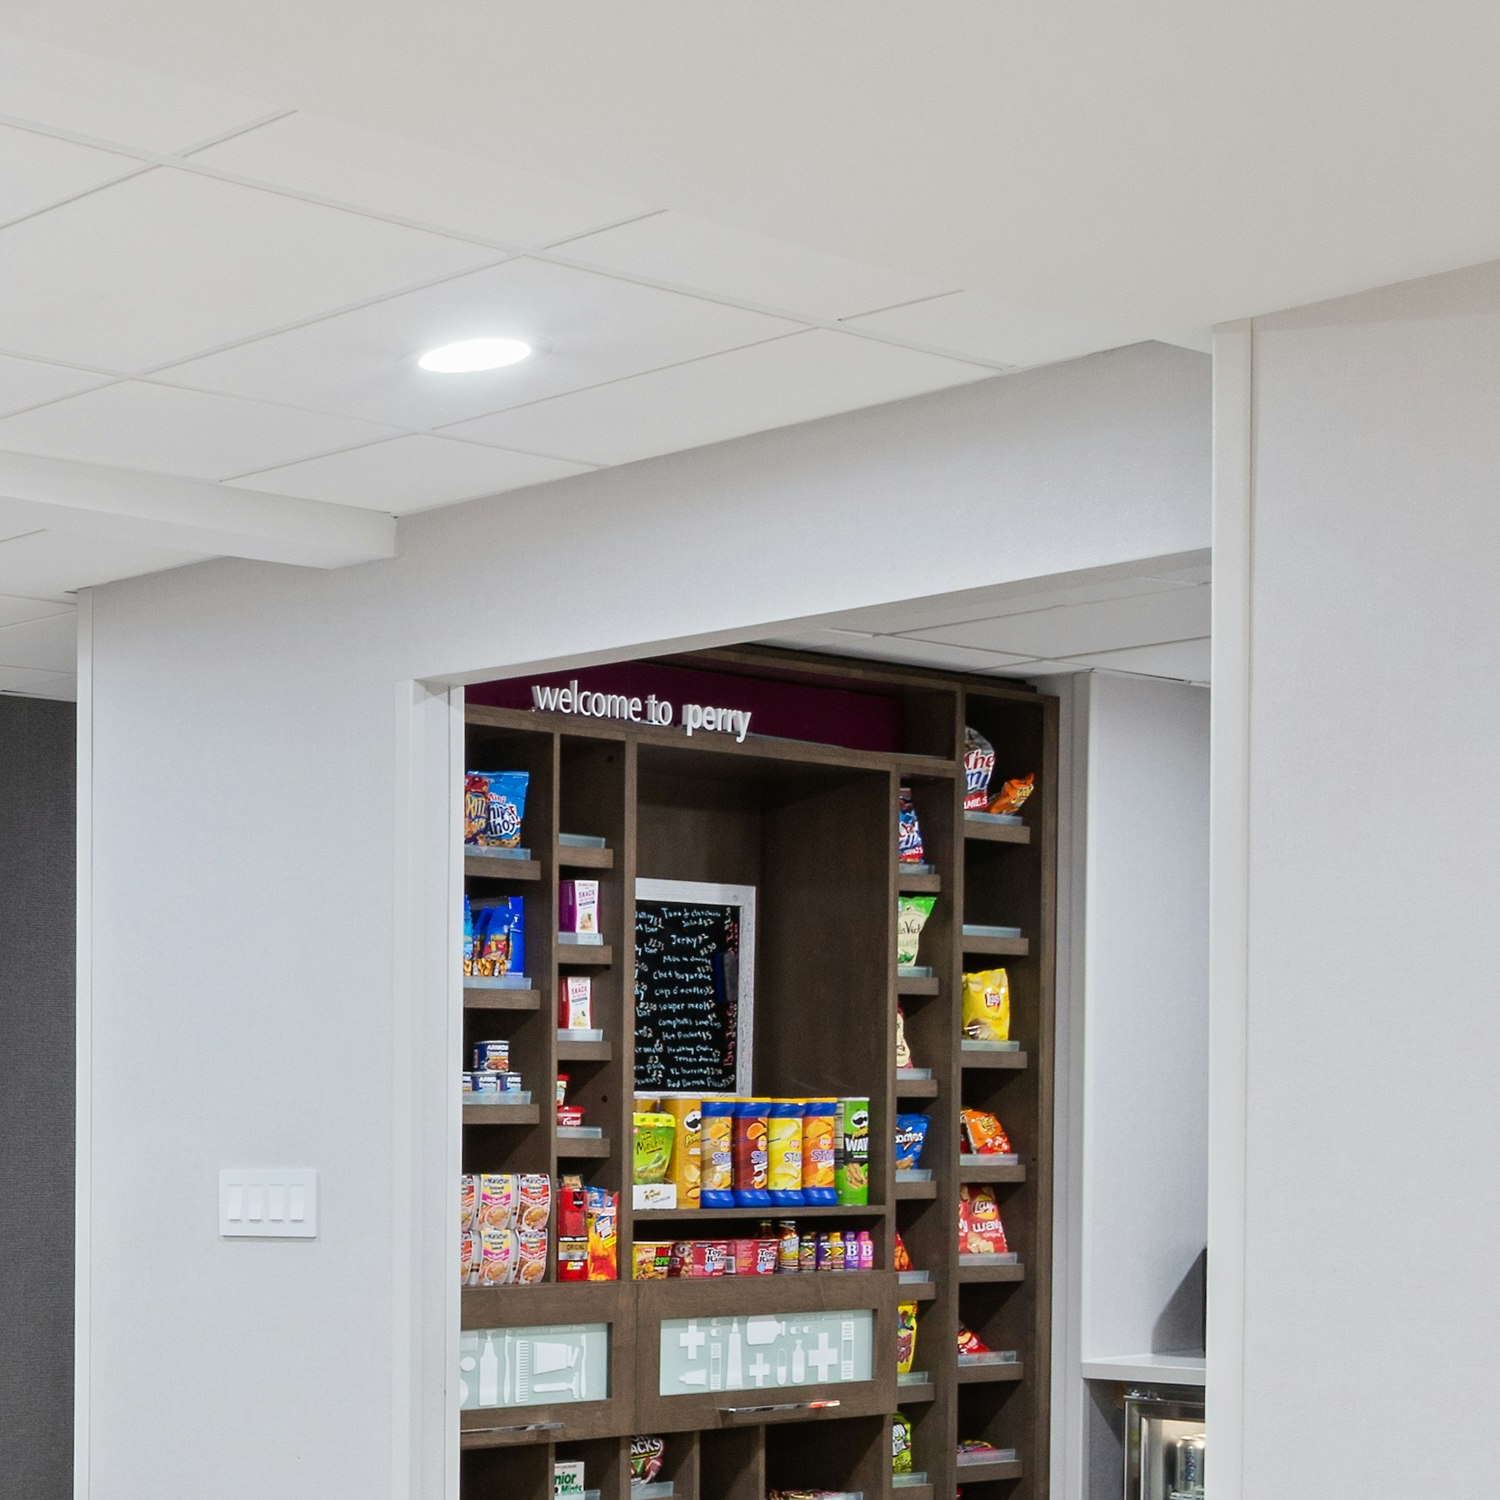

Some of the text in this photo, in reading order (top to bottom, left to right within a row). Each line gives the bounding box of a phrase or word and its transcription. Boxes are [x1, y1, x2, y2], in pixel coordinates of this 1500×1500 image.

[531, 679, 752, 743] welcome to perry
[487, 803, 513, 820] hips
[631, 1438, 662, 1455] ACKS
[554, 1471, 577, 1486] nior
